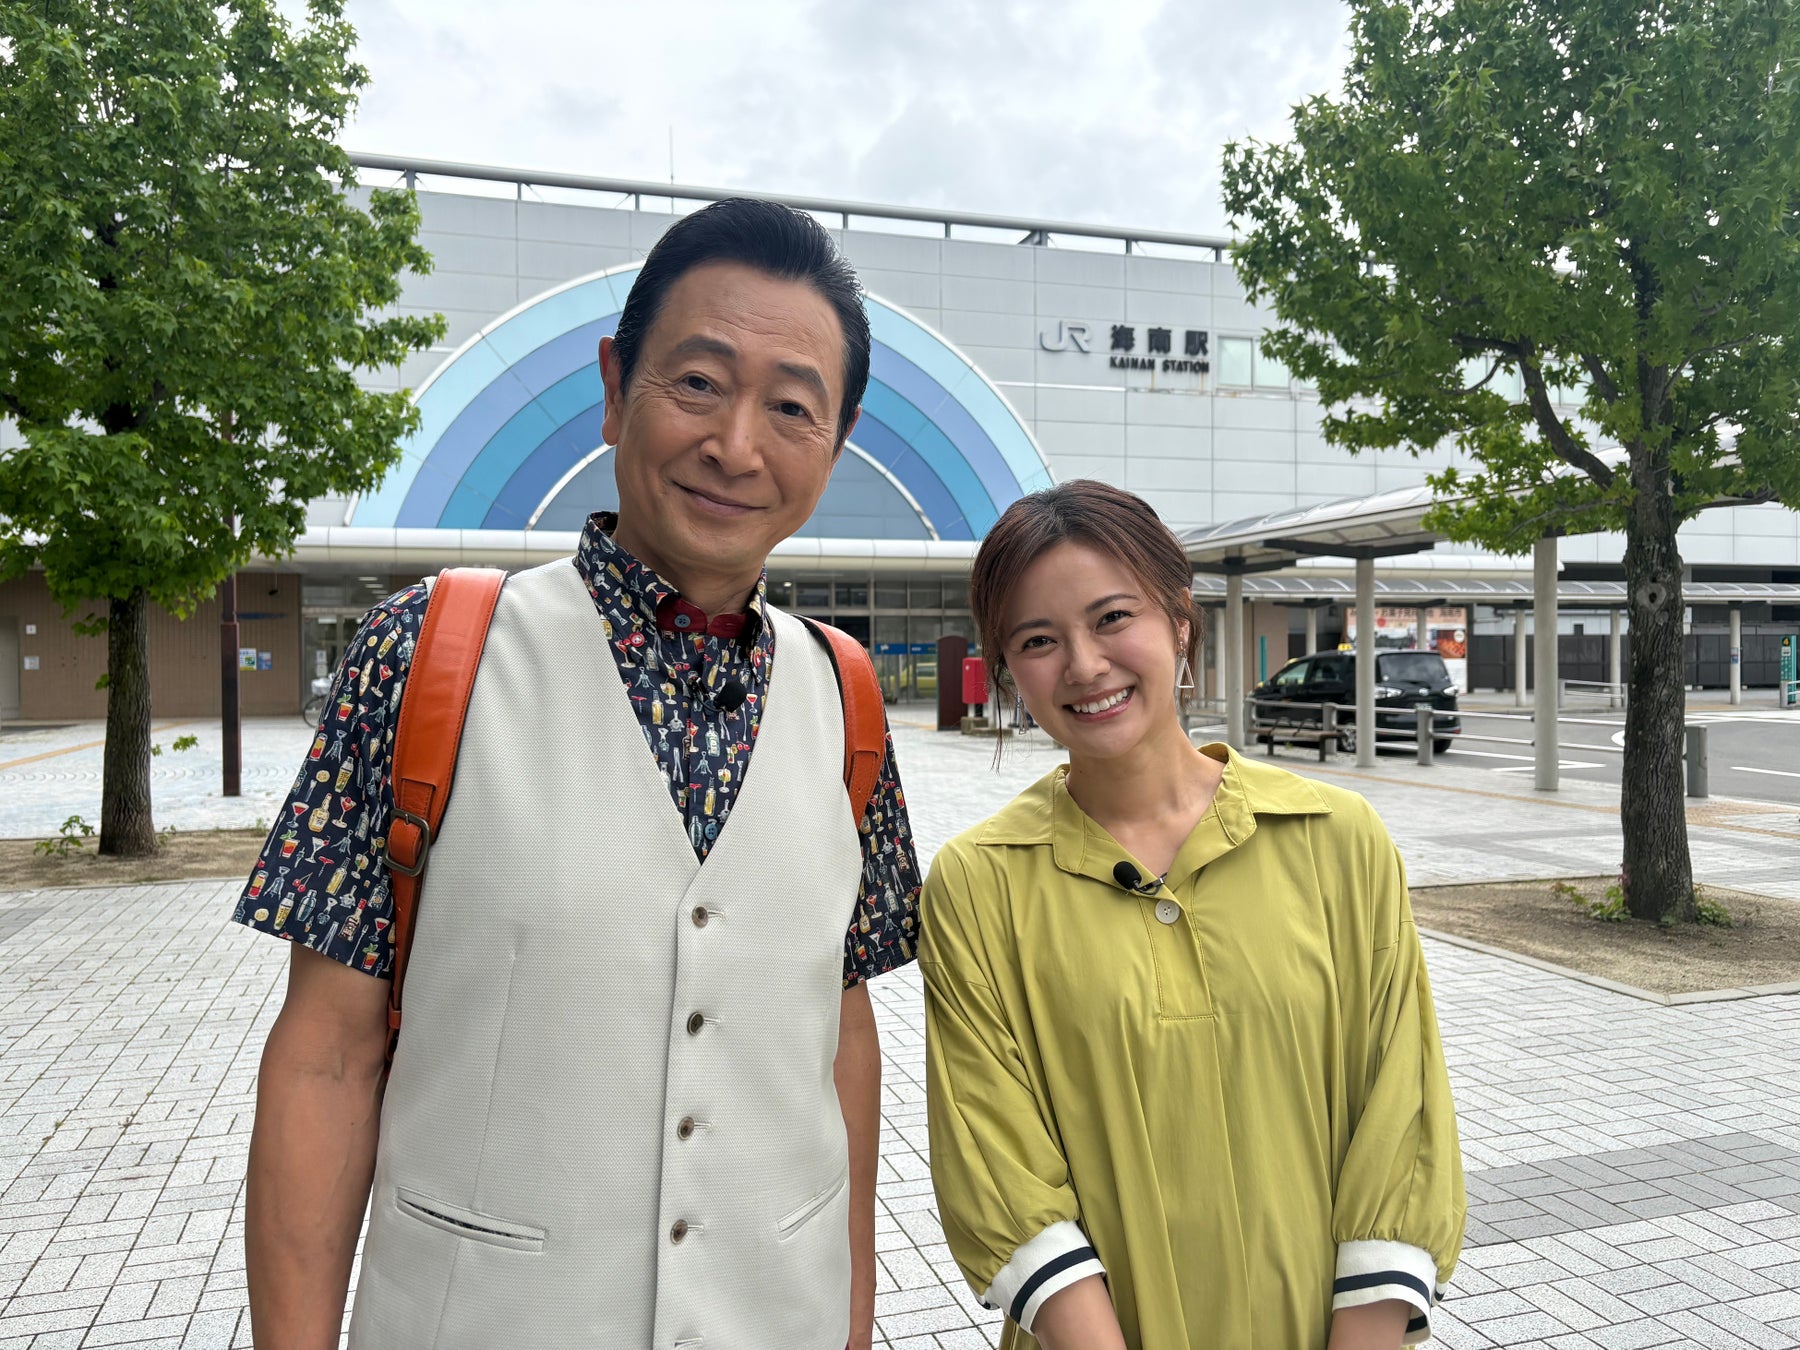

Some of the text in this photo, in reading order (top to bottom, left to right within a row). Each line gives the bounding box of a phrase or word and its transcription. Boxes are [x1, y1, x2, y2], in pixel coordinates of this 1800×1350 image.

[1040, 320, 1209, 356] JR 海南駅
[1110, 357, 1209, 374] KAINAN STATION
